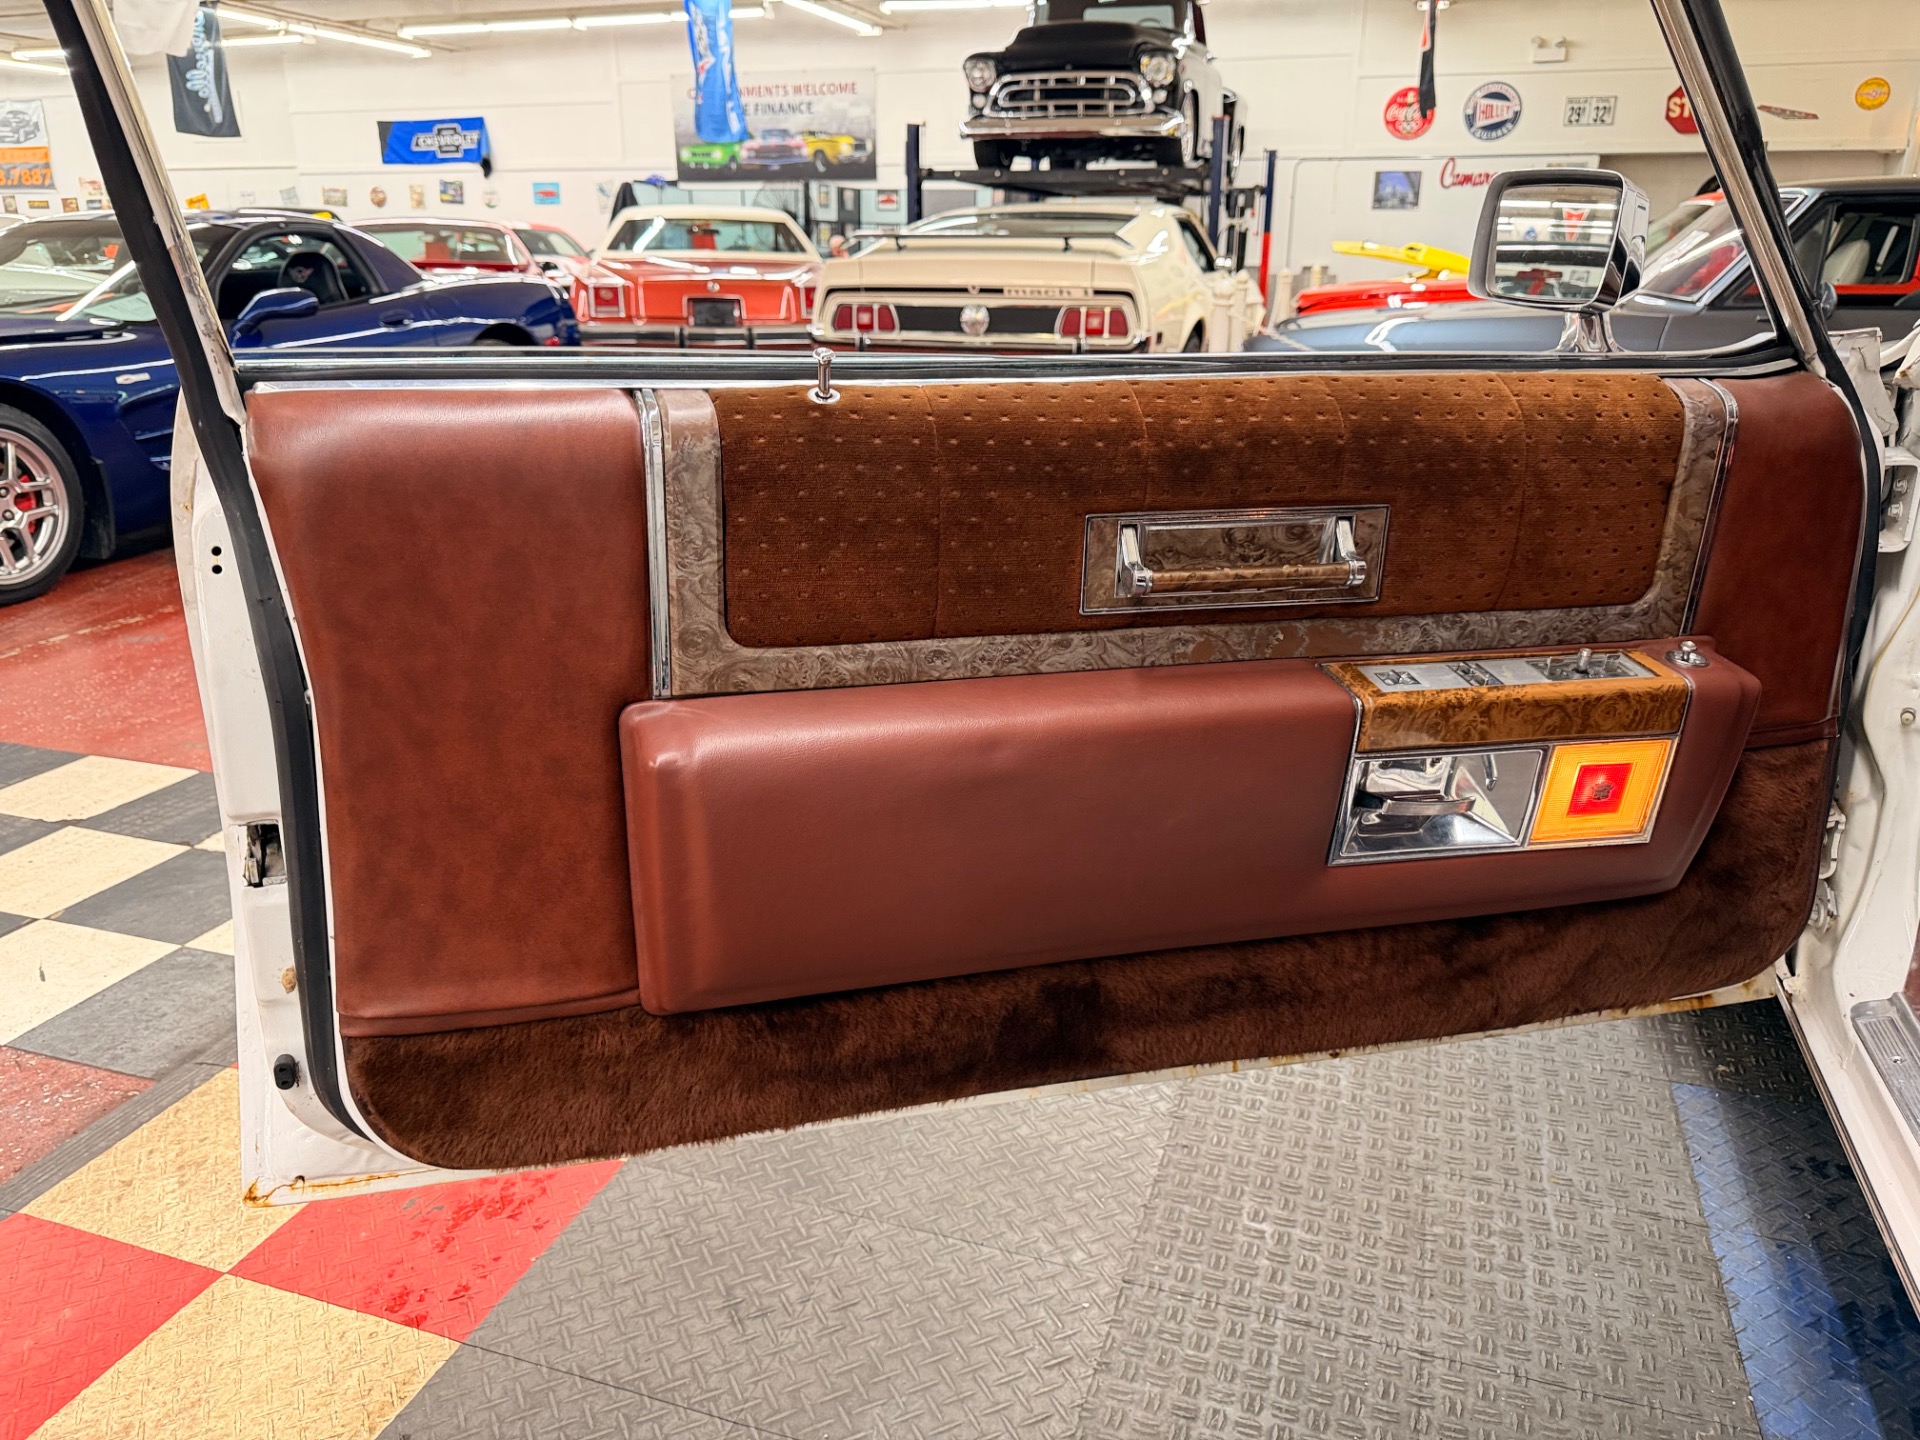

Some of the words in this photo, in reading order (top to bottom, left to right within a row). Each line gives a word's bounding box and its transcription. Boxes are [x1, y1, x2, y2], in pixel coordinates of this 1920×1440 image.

[793, 81, 857, 97] WELCOME
[754, 101, 815, 115] FINANCE
[1478, 103, 1511, 122] HOLLEY
[1668, 97, 1690, 118] ST
